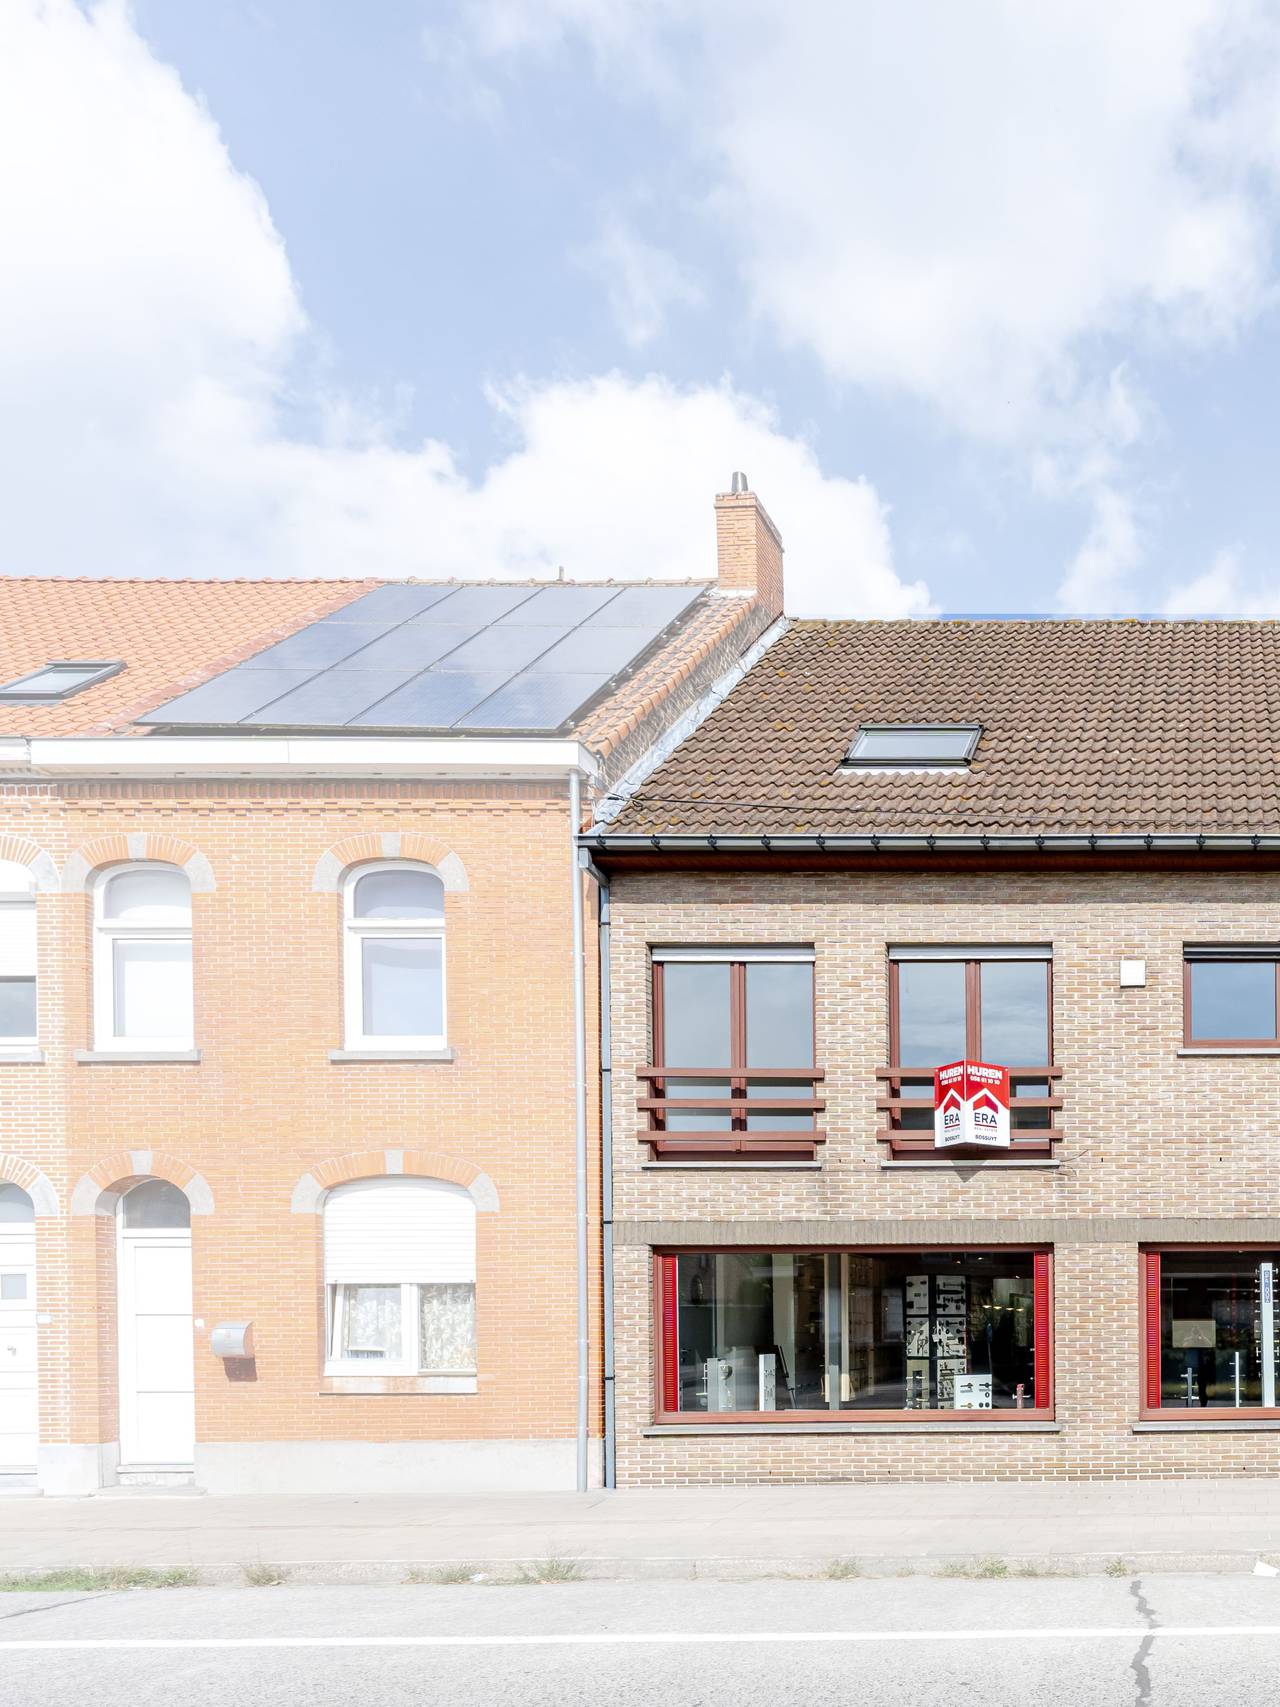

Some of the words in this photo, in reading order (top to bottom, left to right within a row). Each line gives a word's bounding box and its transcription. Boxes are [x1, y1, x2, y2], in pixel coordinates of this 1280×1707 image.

[940, 1065, 963, 1080] HUREN
[967, 1065, 1002, 1080] HUREN
[944, 1113, 960, 1125] ERA
[974, 1112, 997, 1125] ERA
[975, 1134, 997, 1142] BOSSUYT
